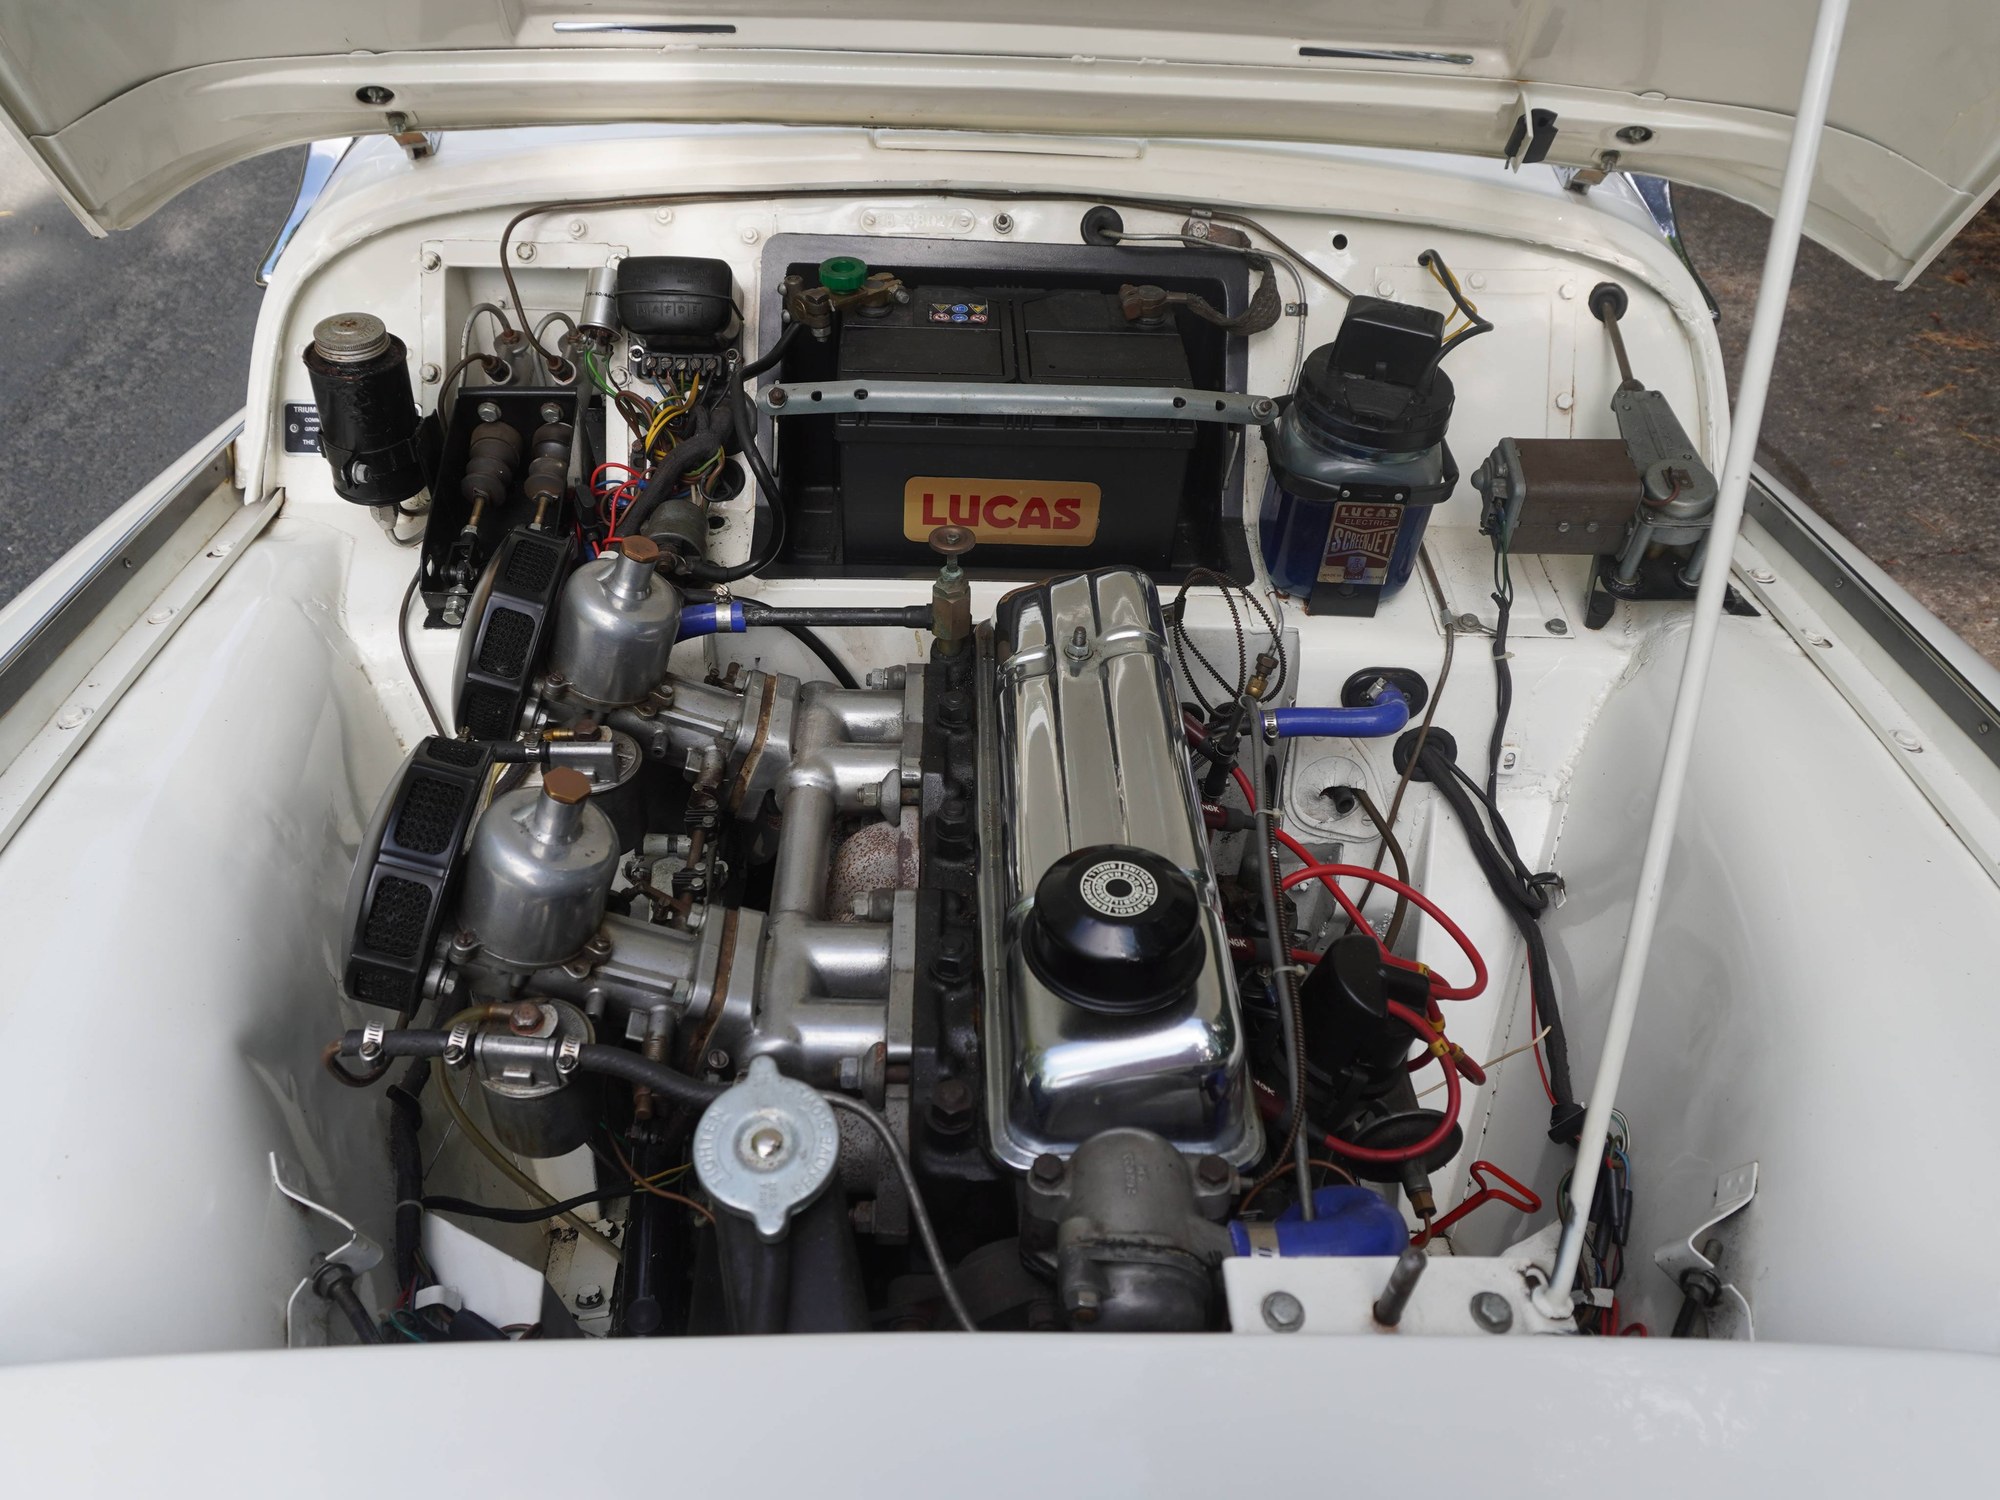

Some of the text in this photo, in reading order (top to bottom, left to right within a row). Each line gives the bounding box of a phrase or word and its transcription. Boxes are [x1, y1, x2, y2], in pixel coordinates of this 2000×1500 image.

[922, 493, 1081, 530] LUCAS
[1340, 506, 1398, 518] LUCAS
[1344, 518, 1389, 526] ELECTRIC
[1331, 527, 1395, 554] SCREENJET
[1201, 804, 1220, 813] NGK
[1088, 863, 1117, 877] SHELL
[1113, 893, 1142, 906] MOBIL
[1113, 895, 1153, 914] CASTROL
[1228, 937, 1247, 947] NGK
[1253, 1079, 1275, 1097] NGK
[791, 1137, 832, 1194] REMOVE
